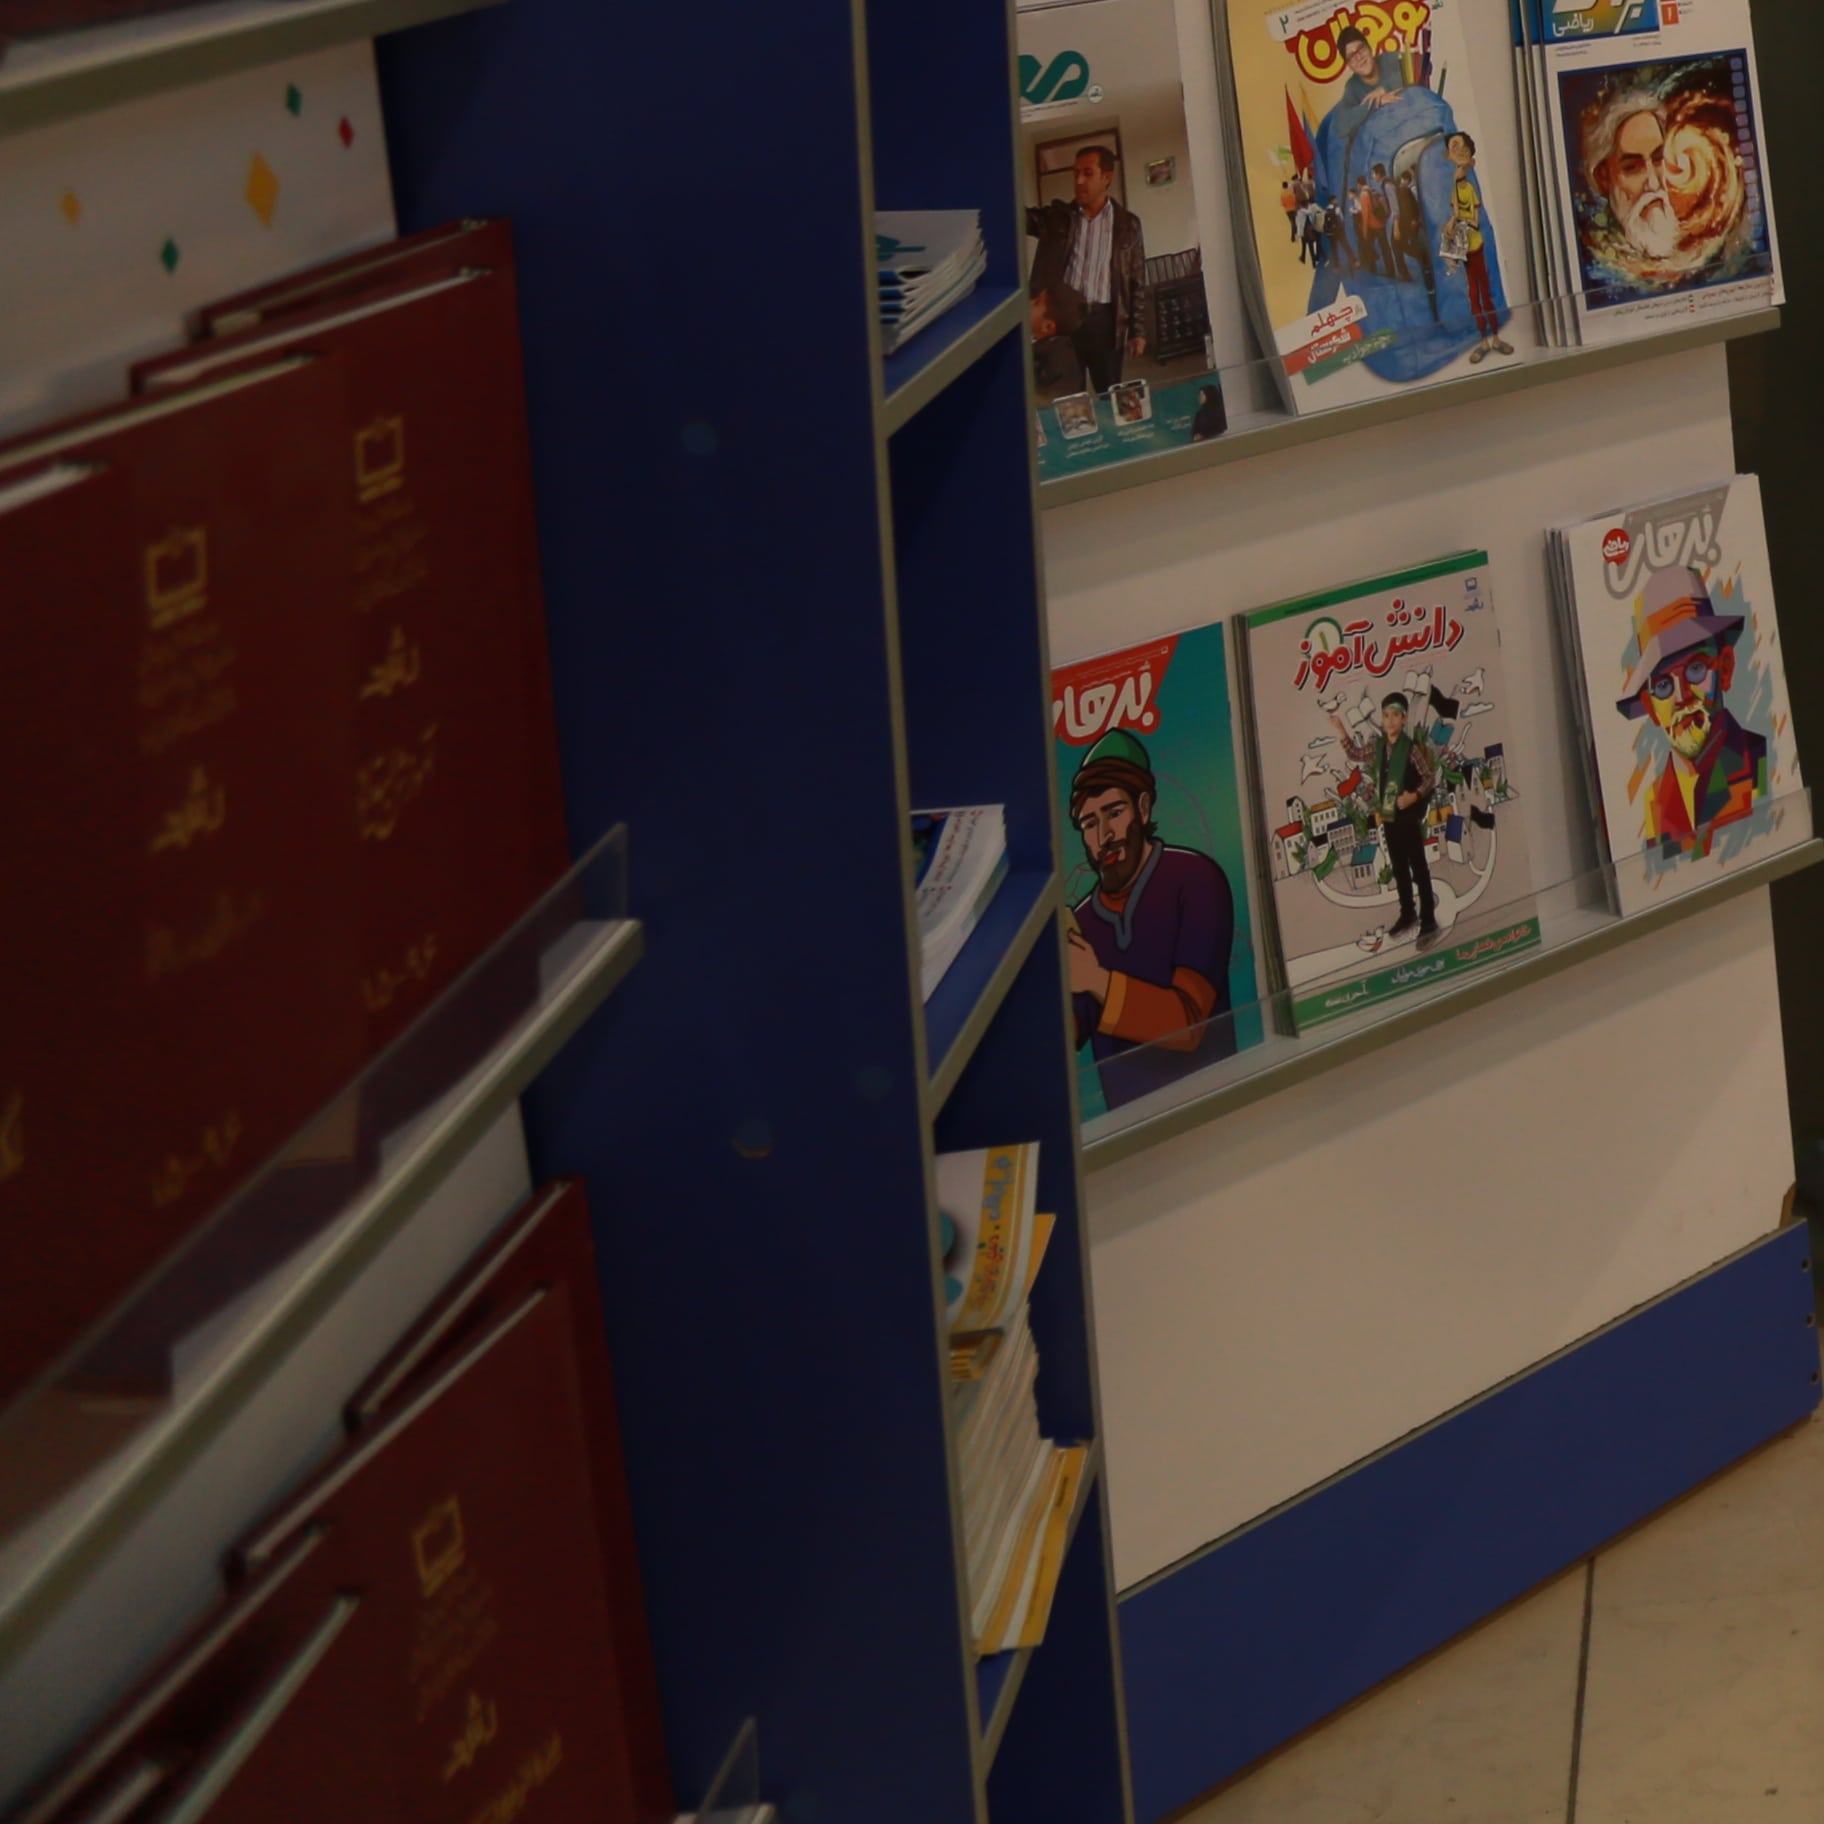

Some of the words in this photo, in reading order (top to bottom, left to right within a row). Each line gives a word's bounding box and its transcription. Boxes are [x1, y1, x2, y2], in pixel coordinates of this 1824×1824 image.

[1552, 12, 1594, 37] ریاضی
[1293, 619, 1374, 693] آموز
[1363, 597, 1465, 678] دانش
